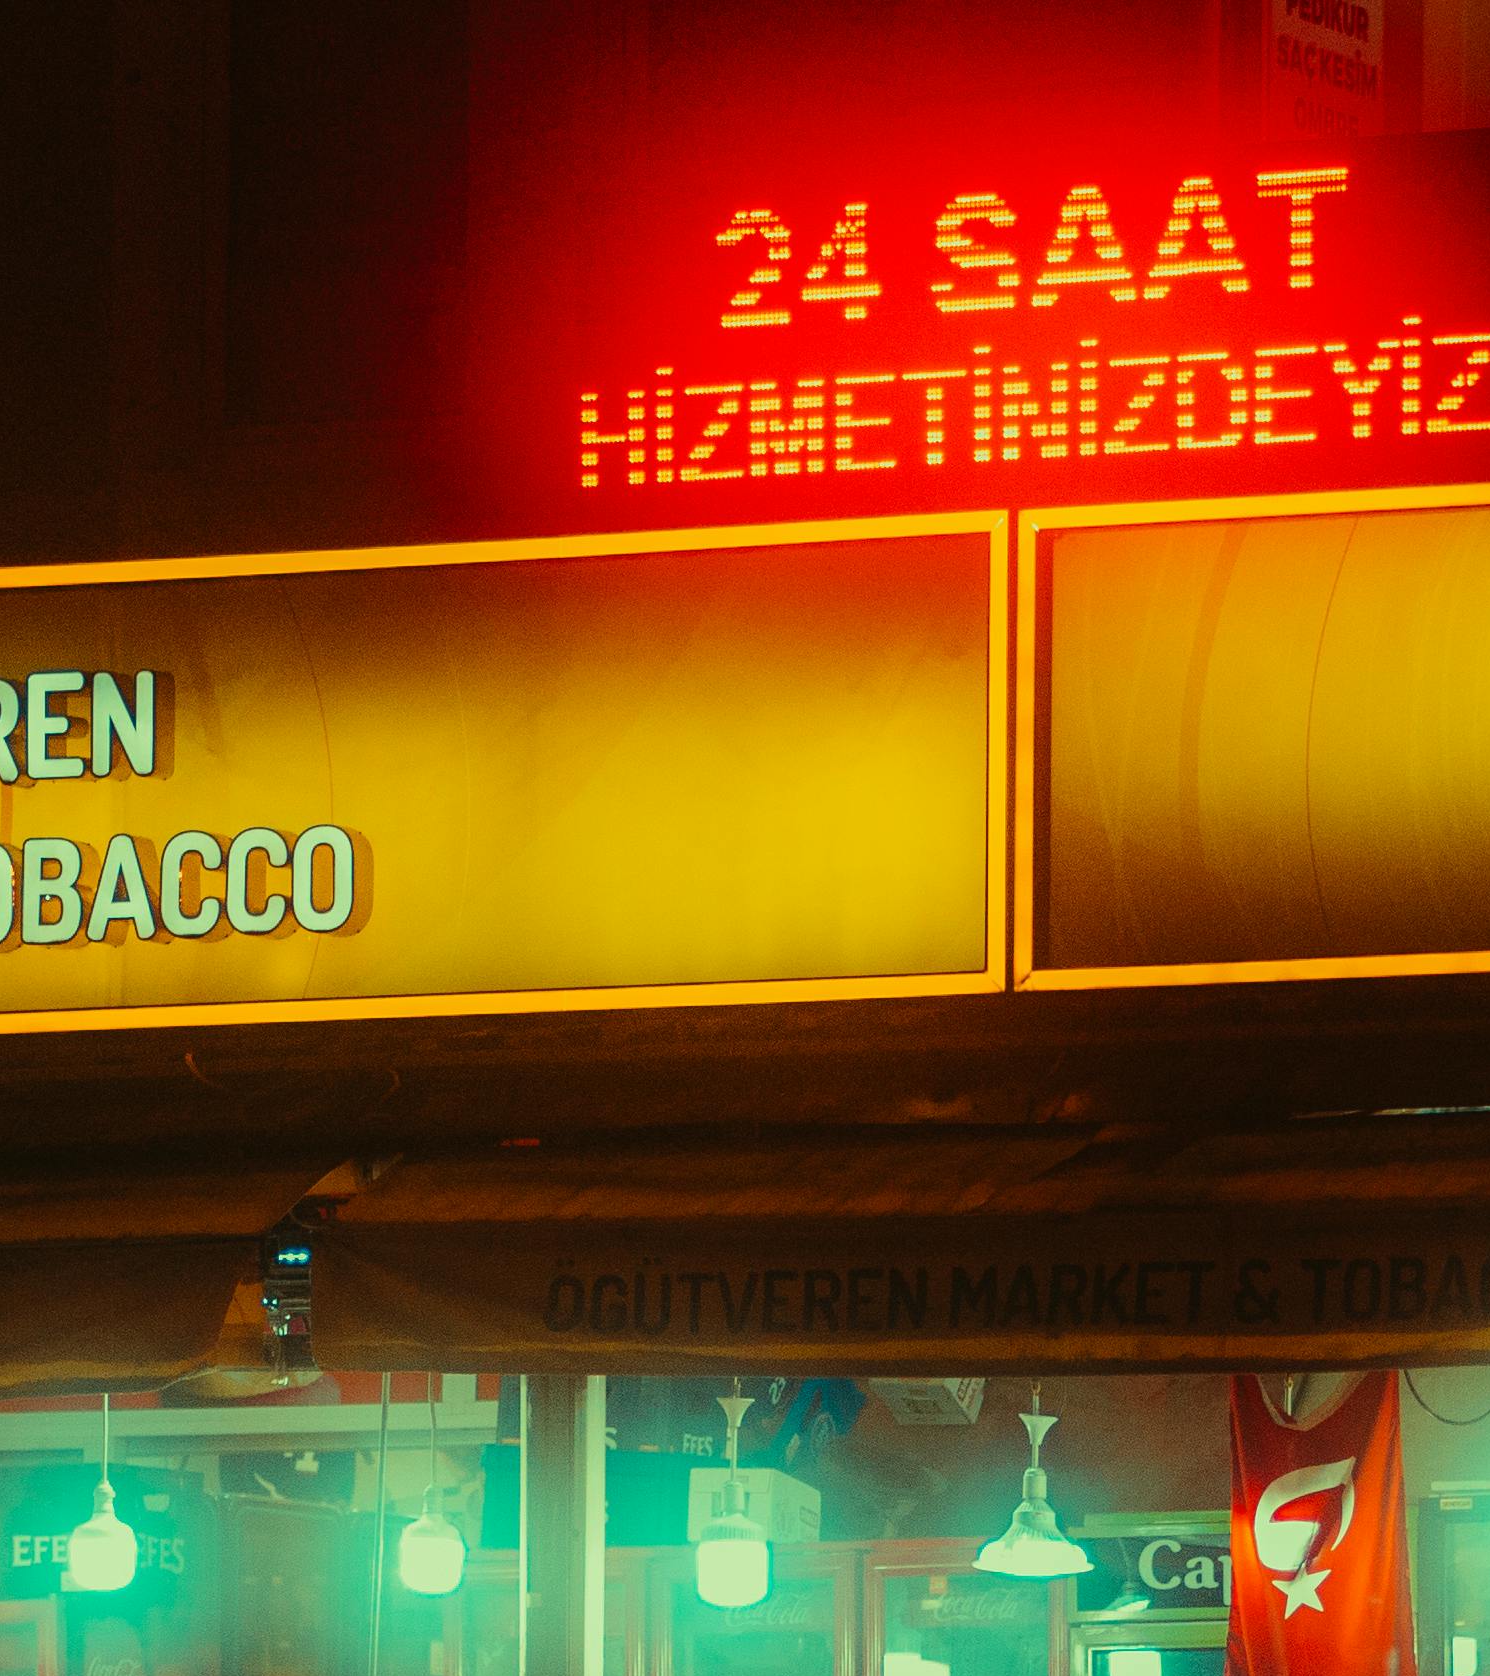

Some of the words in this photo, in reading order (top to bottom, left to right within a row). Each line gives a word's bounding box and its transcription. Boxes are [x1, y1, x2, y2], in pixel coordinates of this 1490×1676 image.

[715, 200, 882, 328] 24
[930, 166, 1351, 314] SAAT
[947, 1258, 1216, 1331] MARKET
[1232, 1256, 1281, 1326] &
[12, 1534, 69, 1567] EFE
